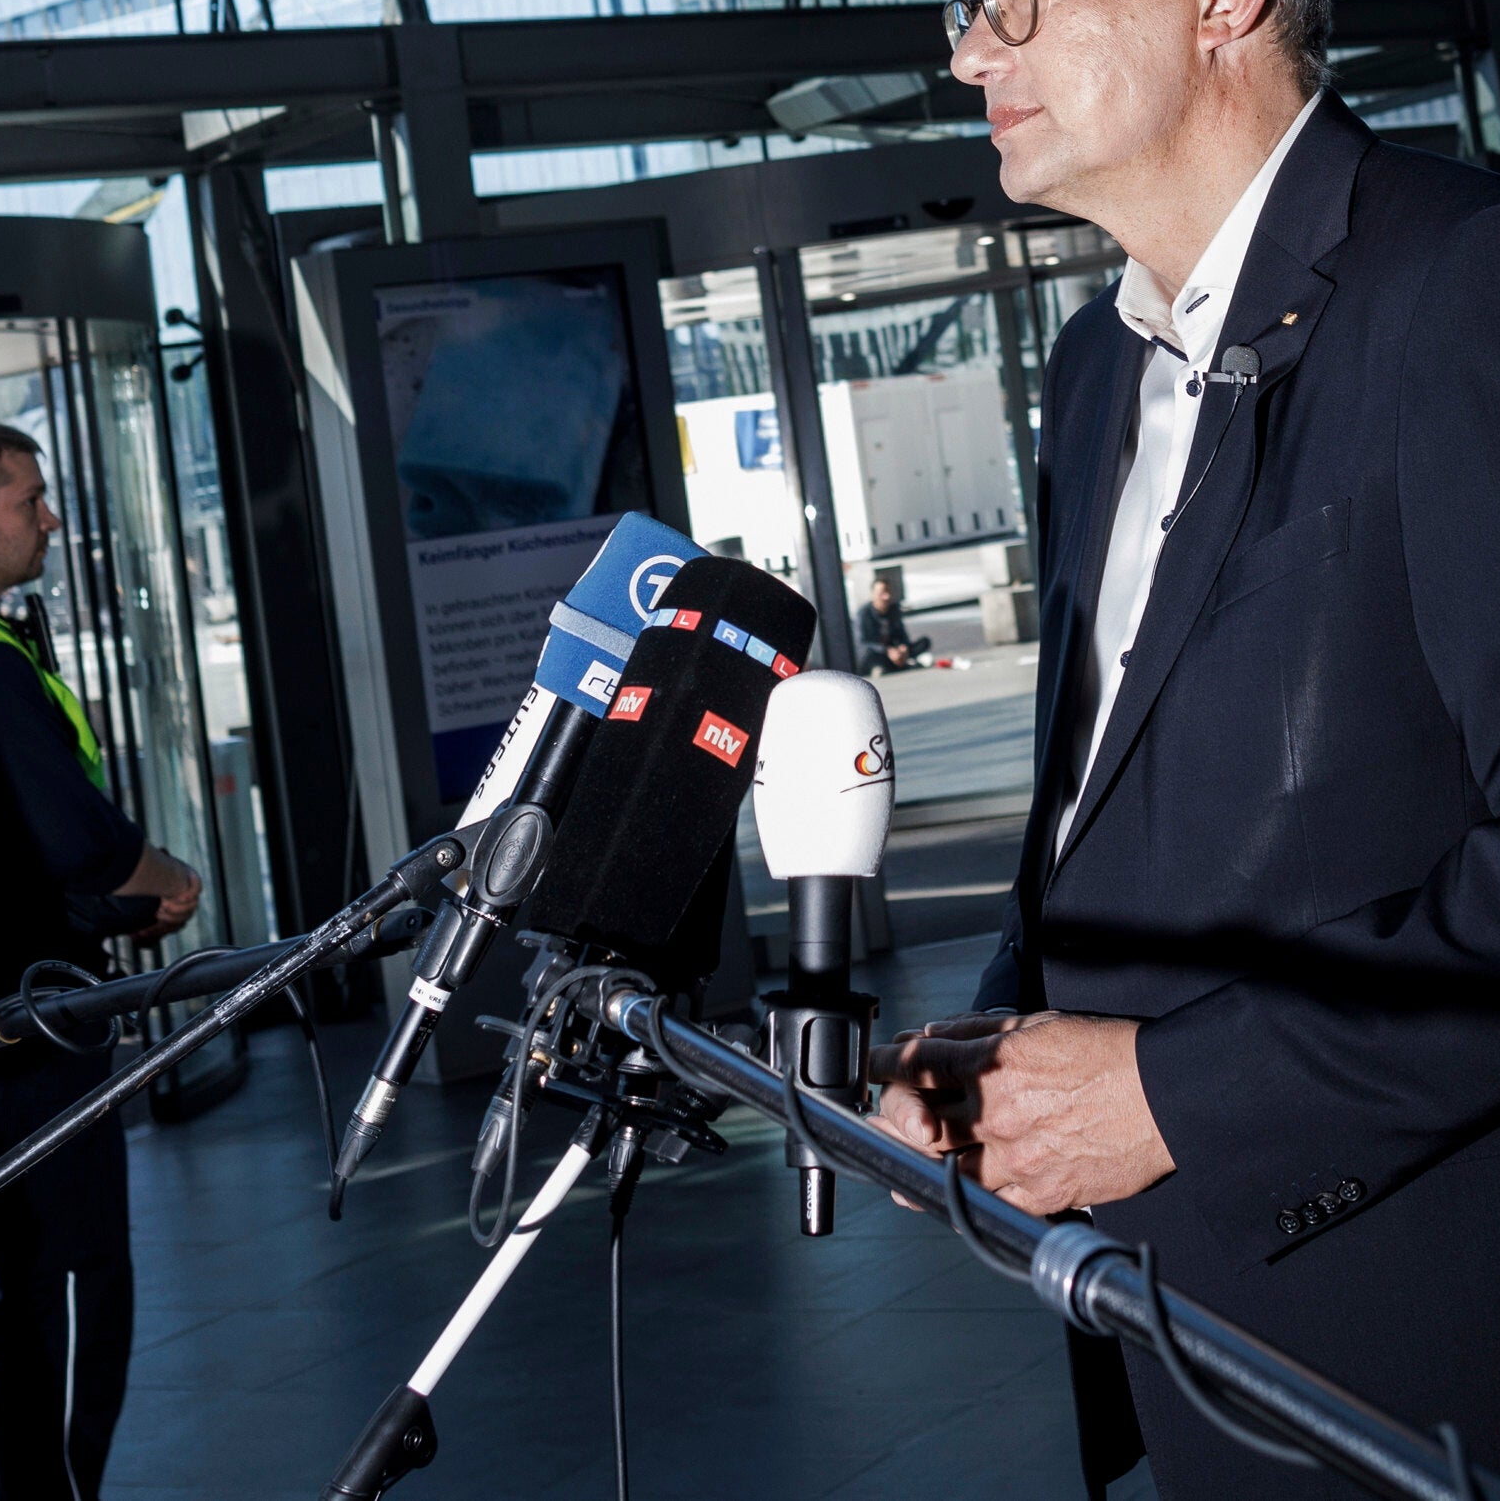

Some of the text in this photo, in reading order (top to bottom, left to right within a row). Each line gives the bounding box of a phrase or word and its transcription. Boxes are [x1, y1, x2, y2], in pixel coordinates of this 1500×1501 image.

[720, 626, 789, 677] RTL
[588, 676, 617, 698] rb
[615, 691, 645, 713] ntv
[703, 723, 741, 756] ntv
